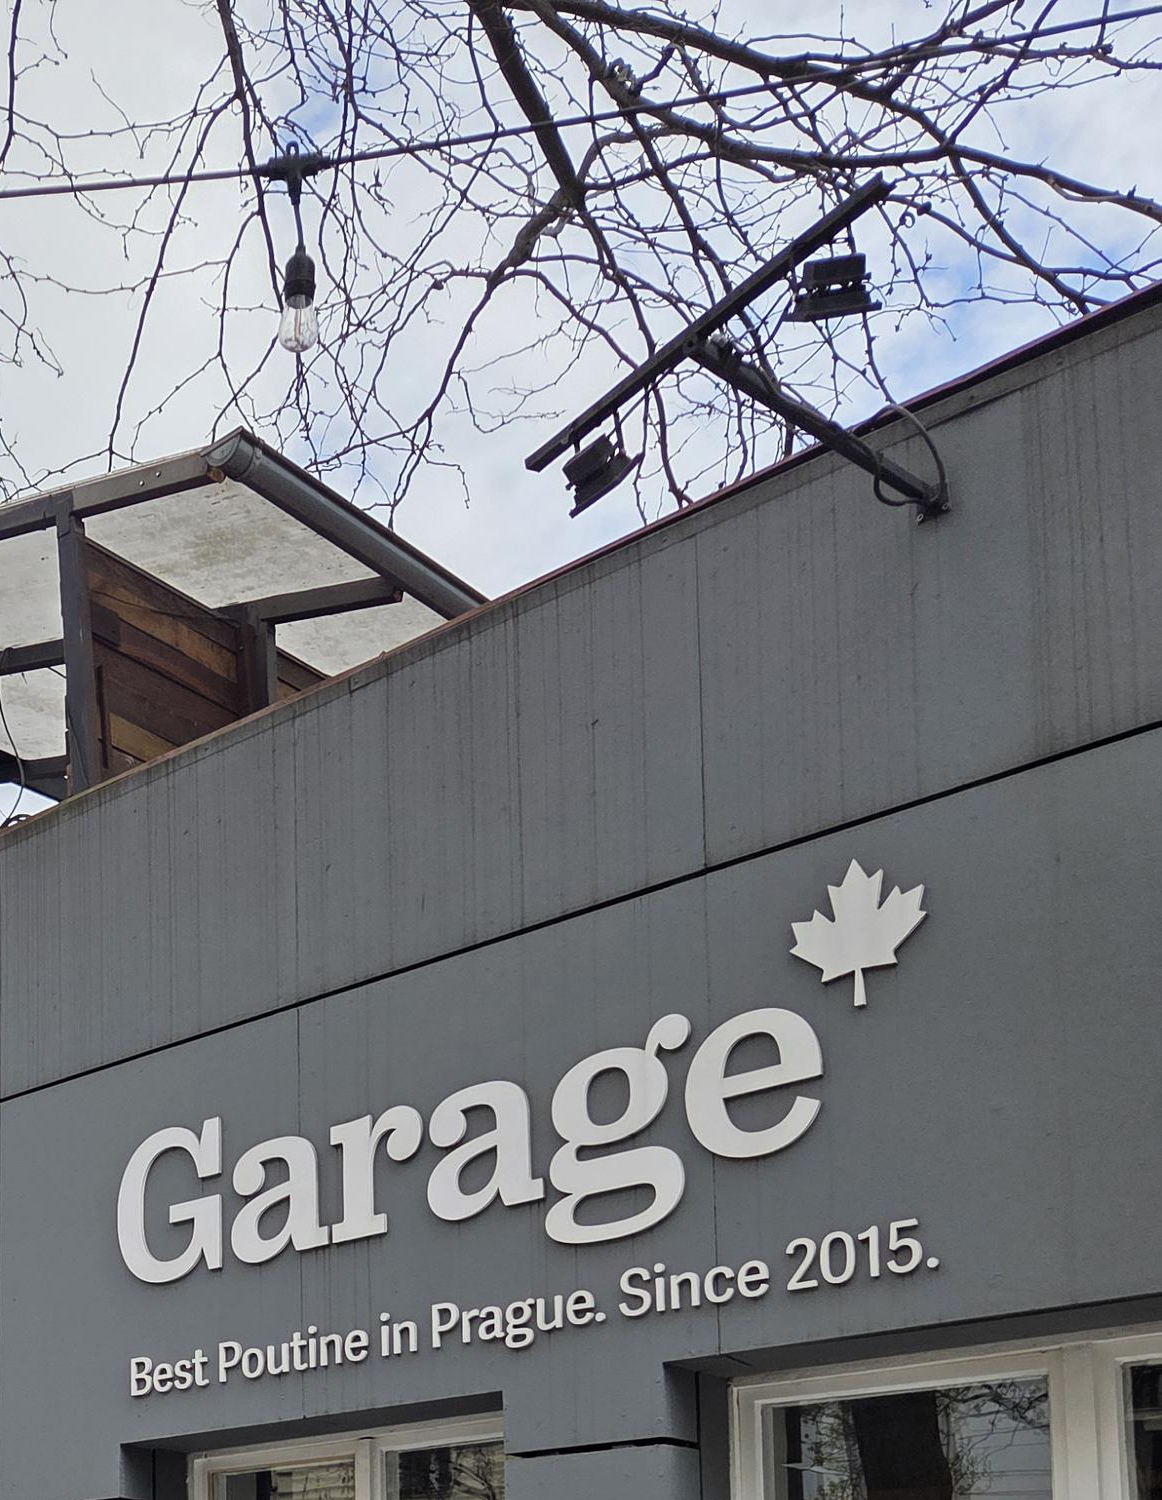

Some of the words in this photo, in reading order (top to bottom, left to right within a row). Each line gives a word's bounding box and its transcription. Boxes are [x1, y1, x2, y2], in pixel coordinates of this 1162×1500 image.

[116, 1006, 824, 1284] Garage
[130, 1348, 210, 1397] Best
[218, 1325, 368, 1383] Poutine
[379, 1312, 419, 1358] in
[430, 1288, 607, 1351] Prague.
[618, 1259, 770, 1318] Since
[787, 1217, 941, 1293] 2015.
